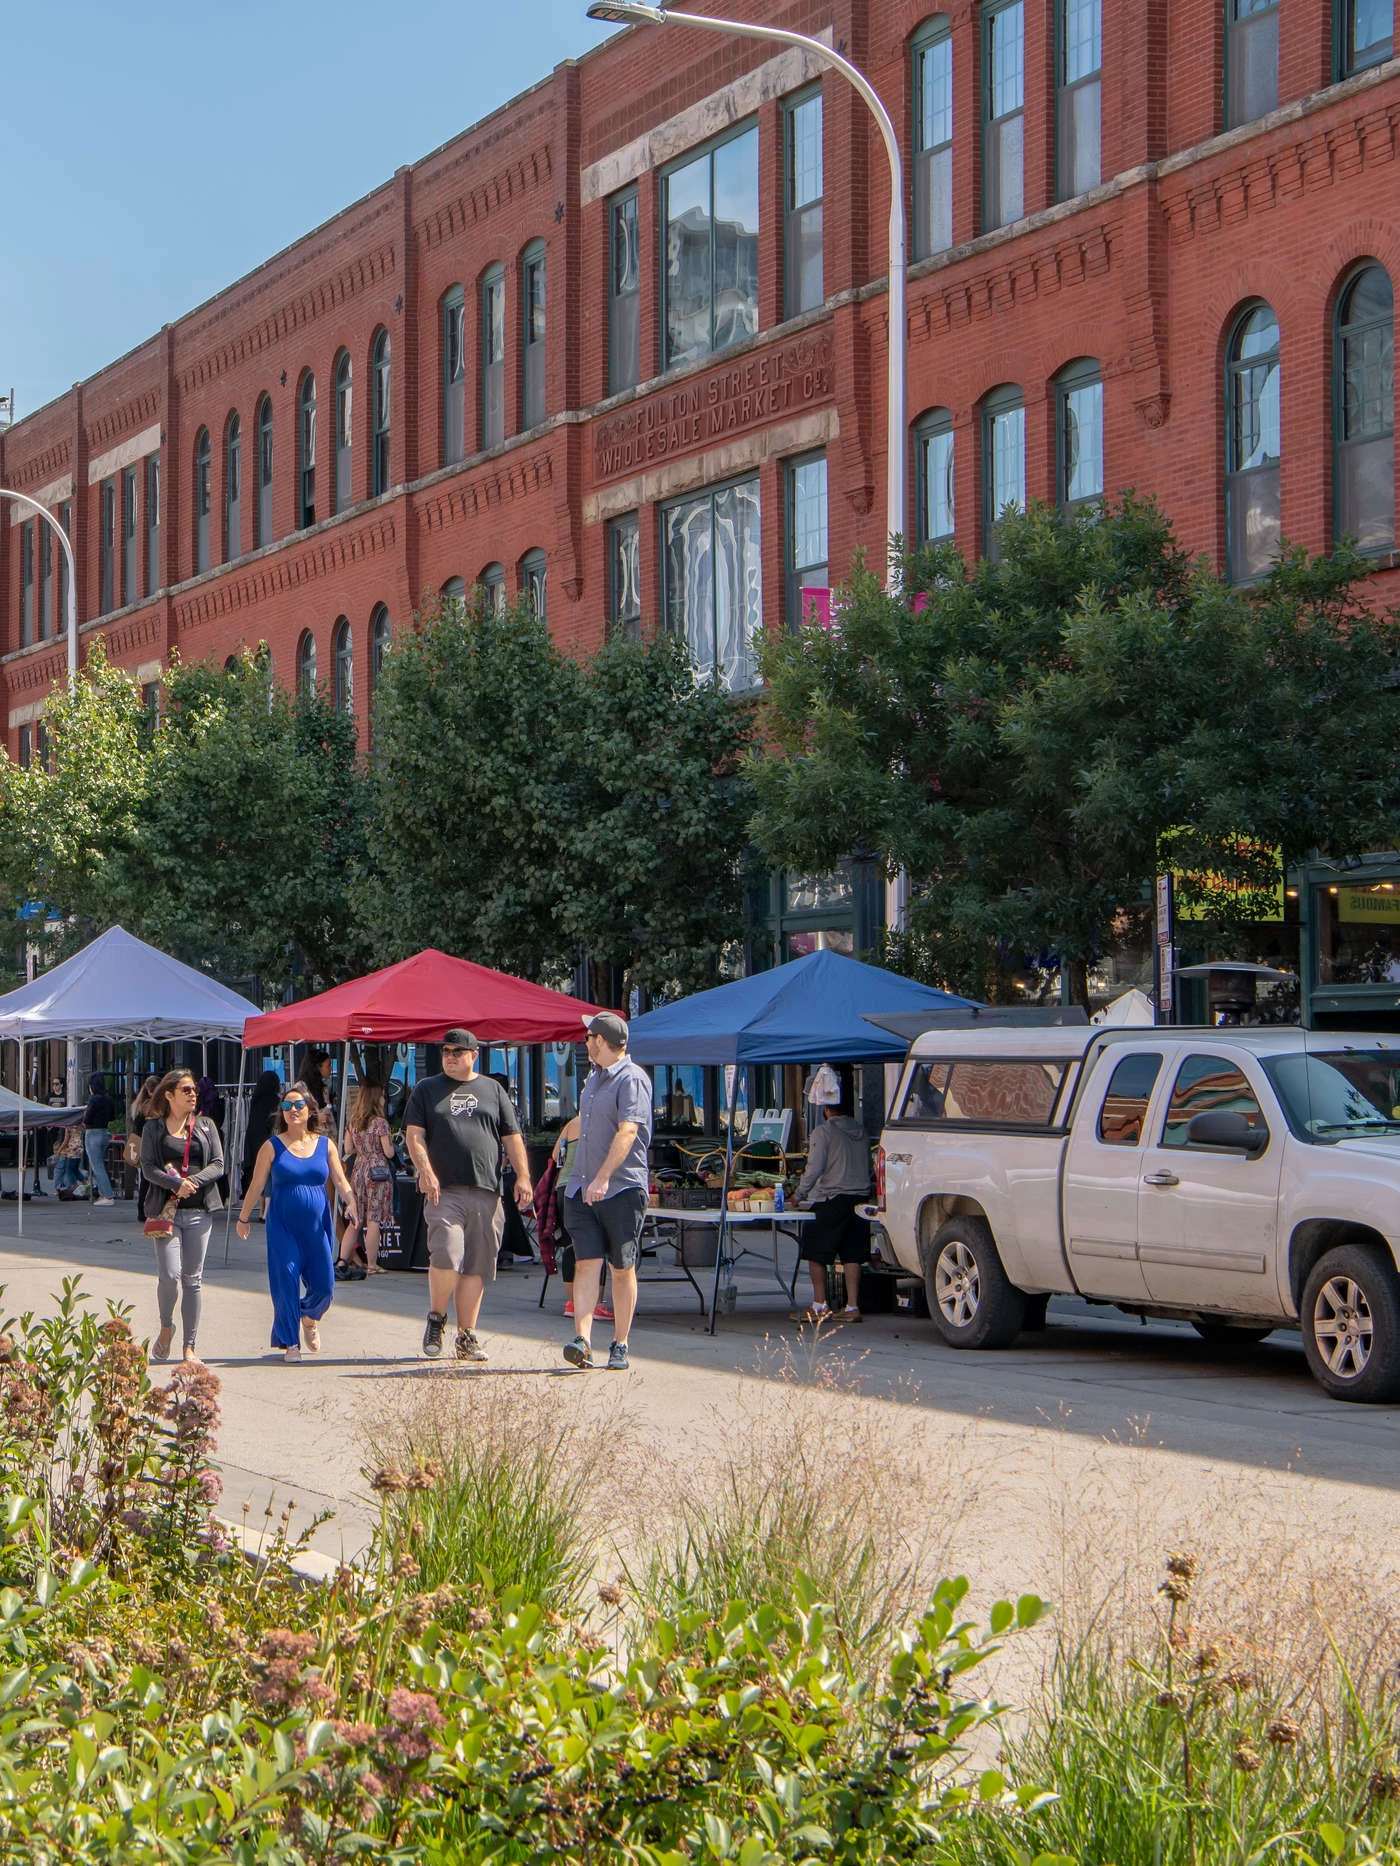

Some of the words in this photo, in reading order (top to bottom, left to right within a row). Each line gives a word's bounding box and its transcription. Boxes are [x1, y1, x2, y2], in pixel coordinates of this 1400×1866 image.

[602, 415, 700, 475] WHOLESALE
[711, 380, 792, 433] MARKET
[636, 388, 700, 434] FULTON
[708, 351, 784, 404] STREET
